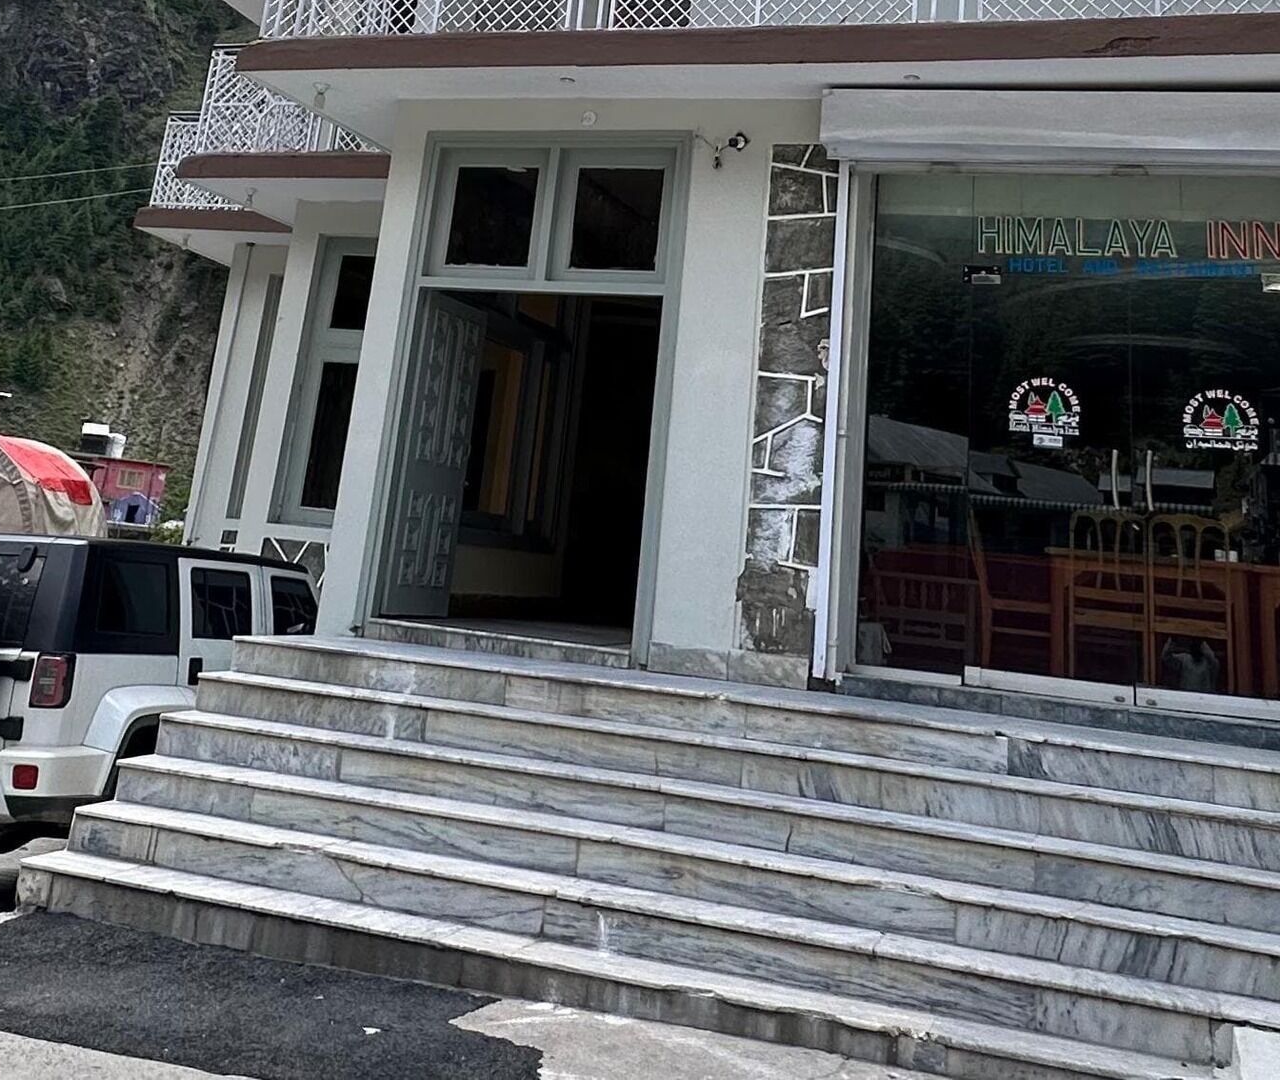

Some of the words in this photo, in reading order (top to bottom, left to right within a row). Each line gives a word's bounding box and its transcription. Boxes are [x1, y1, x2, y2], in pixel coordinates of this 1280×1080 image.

[977, 215, 1179, 258] HIMALAYA
[1008, 257, 1069, 274] HOTEL
[1008, 381, 1030, 410] MOST
[1182, 392, 1204, 424] MOST
